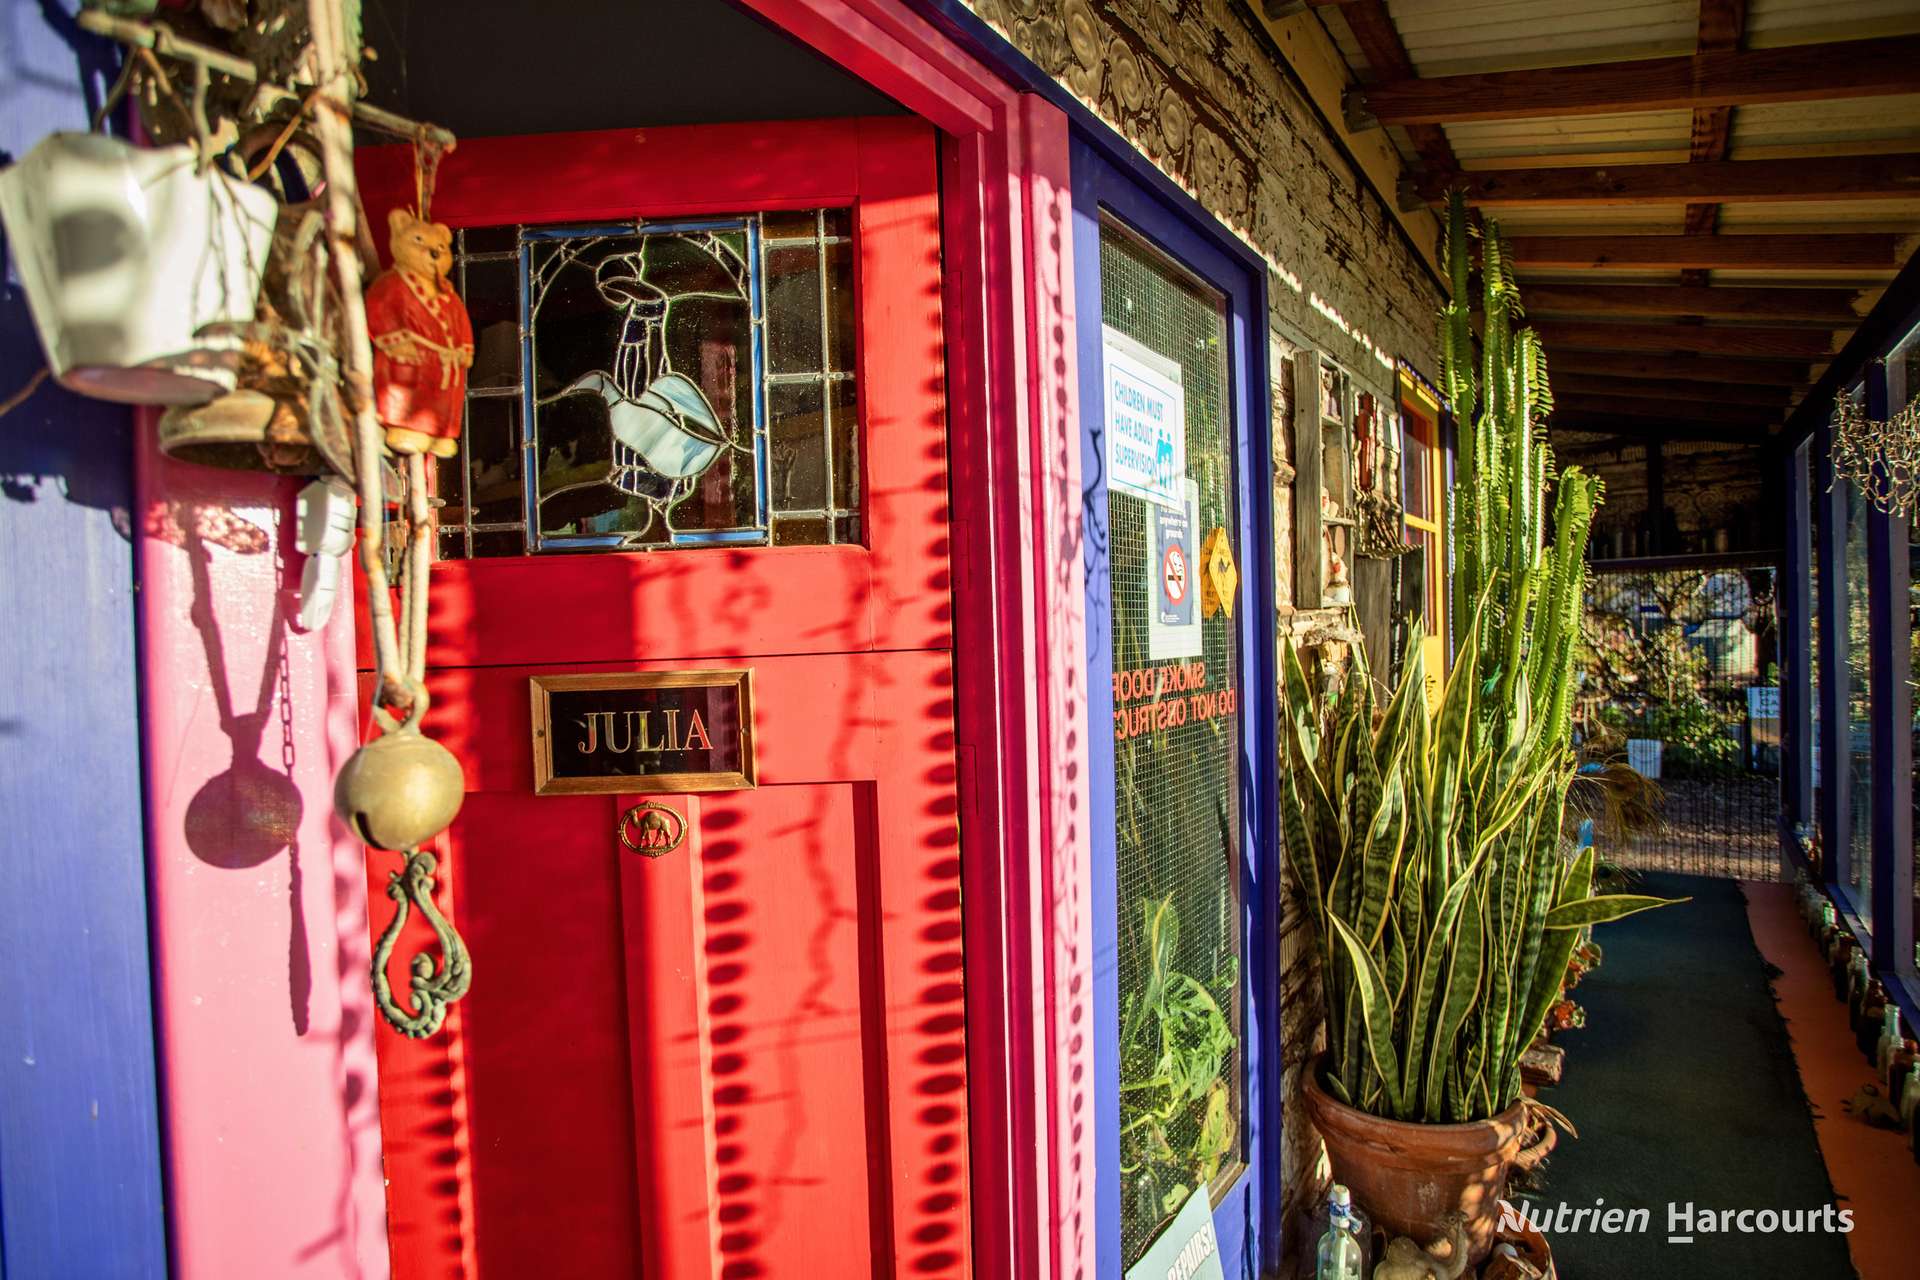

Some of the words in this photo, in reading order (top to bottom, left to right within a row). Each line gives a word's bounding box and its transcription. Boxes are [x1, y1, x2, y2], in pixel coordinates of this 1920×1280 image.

[1114, 379, 1146, 414] CHILDREN
[1147, 395, 1164, 422] MUST
[1114, 410, 1132, 438] HAVE
[1133, 420, 1153, 447] ADULT
[1114, 441, 1156, 476] SUPERVISION
[577, 708, 714, 754] JULIA
